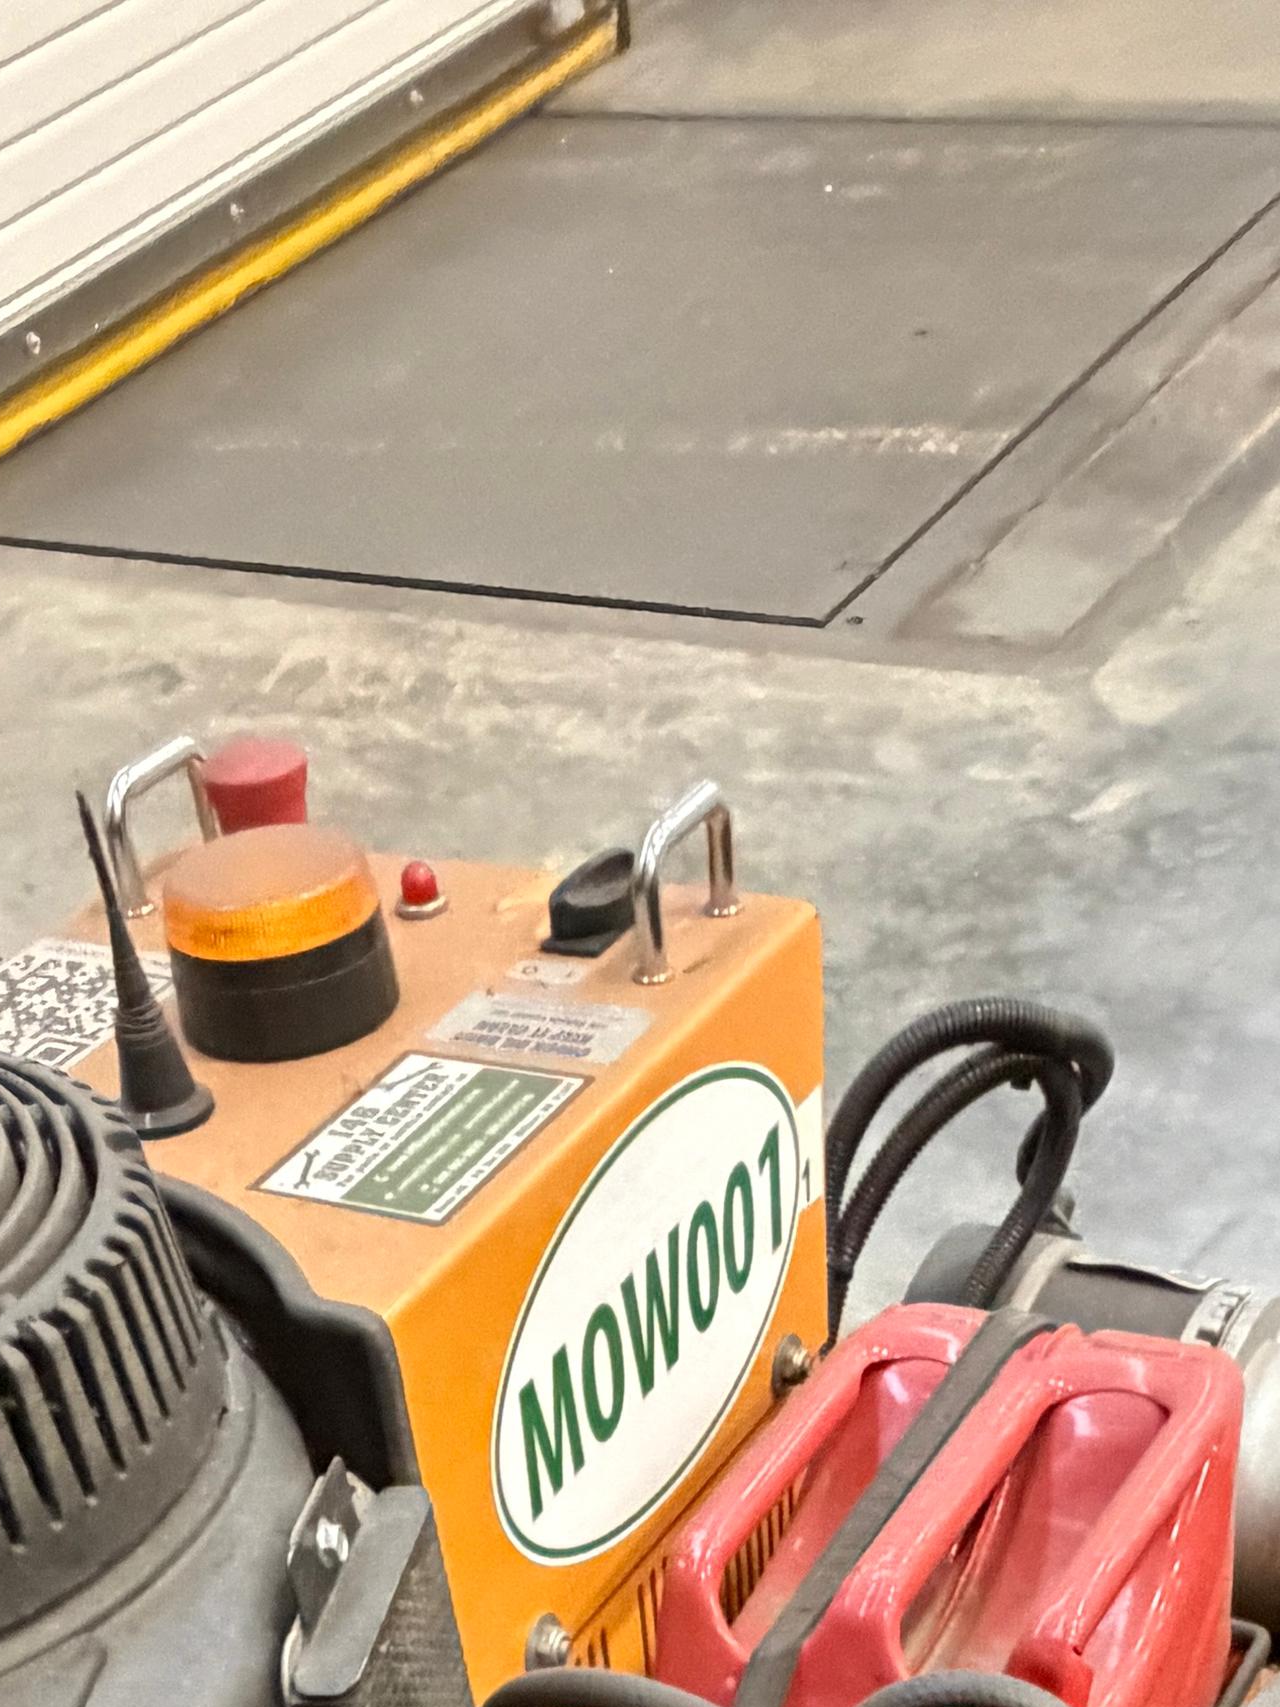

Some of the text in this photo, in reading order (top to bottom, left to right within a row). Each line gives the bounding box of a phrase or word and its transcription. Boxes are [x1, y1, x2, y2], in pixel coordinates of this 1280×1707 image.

[312, 1127, 386, 1181] SUPPLY
[373, 1072, 449, 1126] CENTER
[519, 1120, 782, 1523] MOW001
